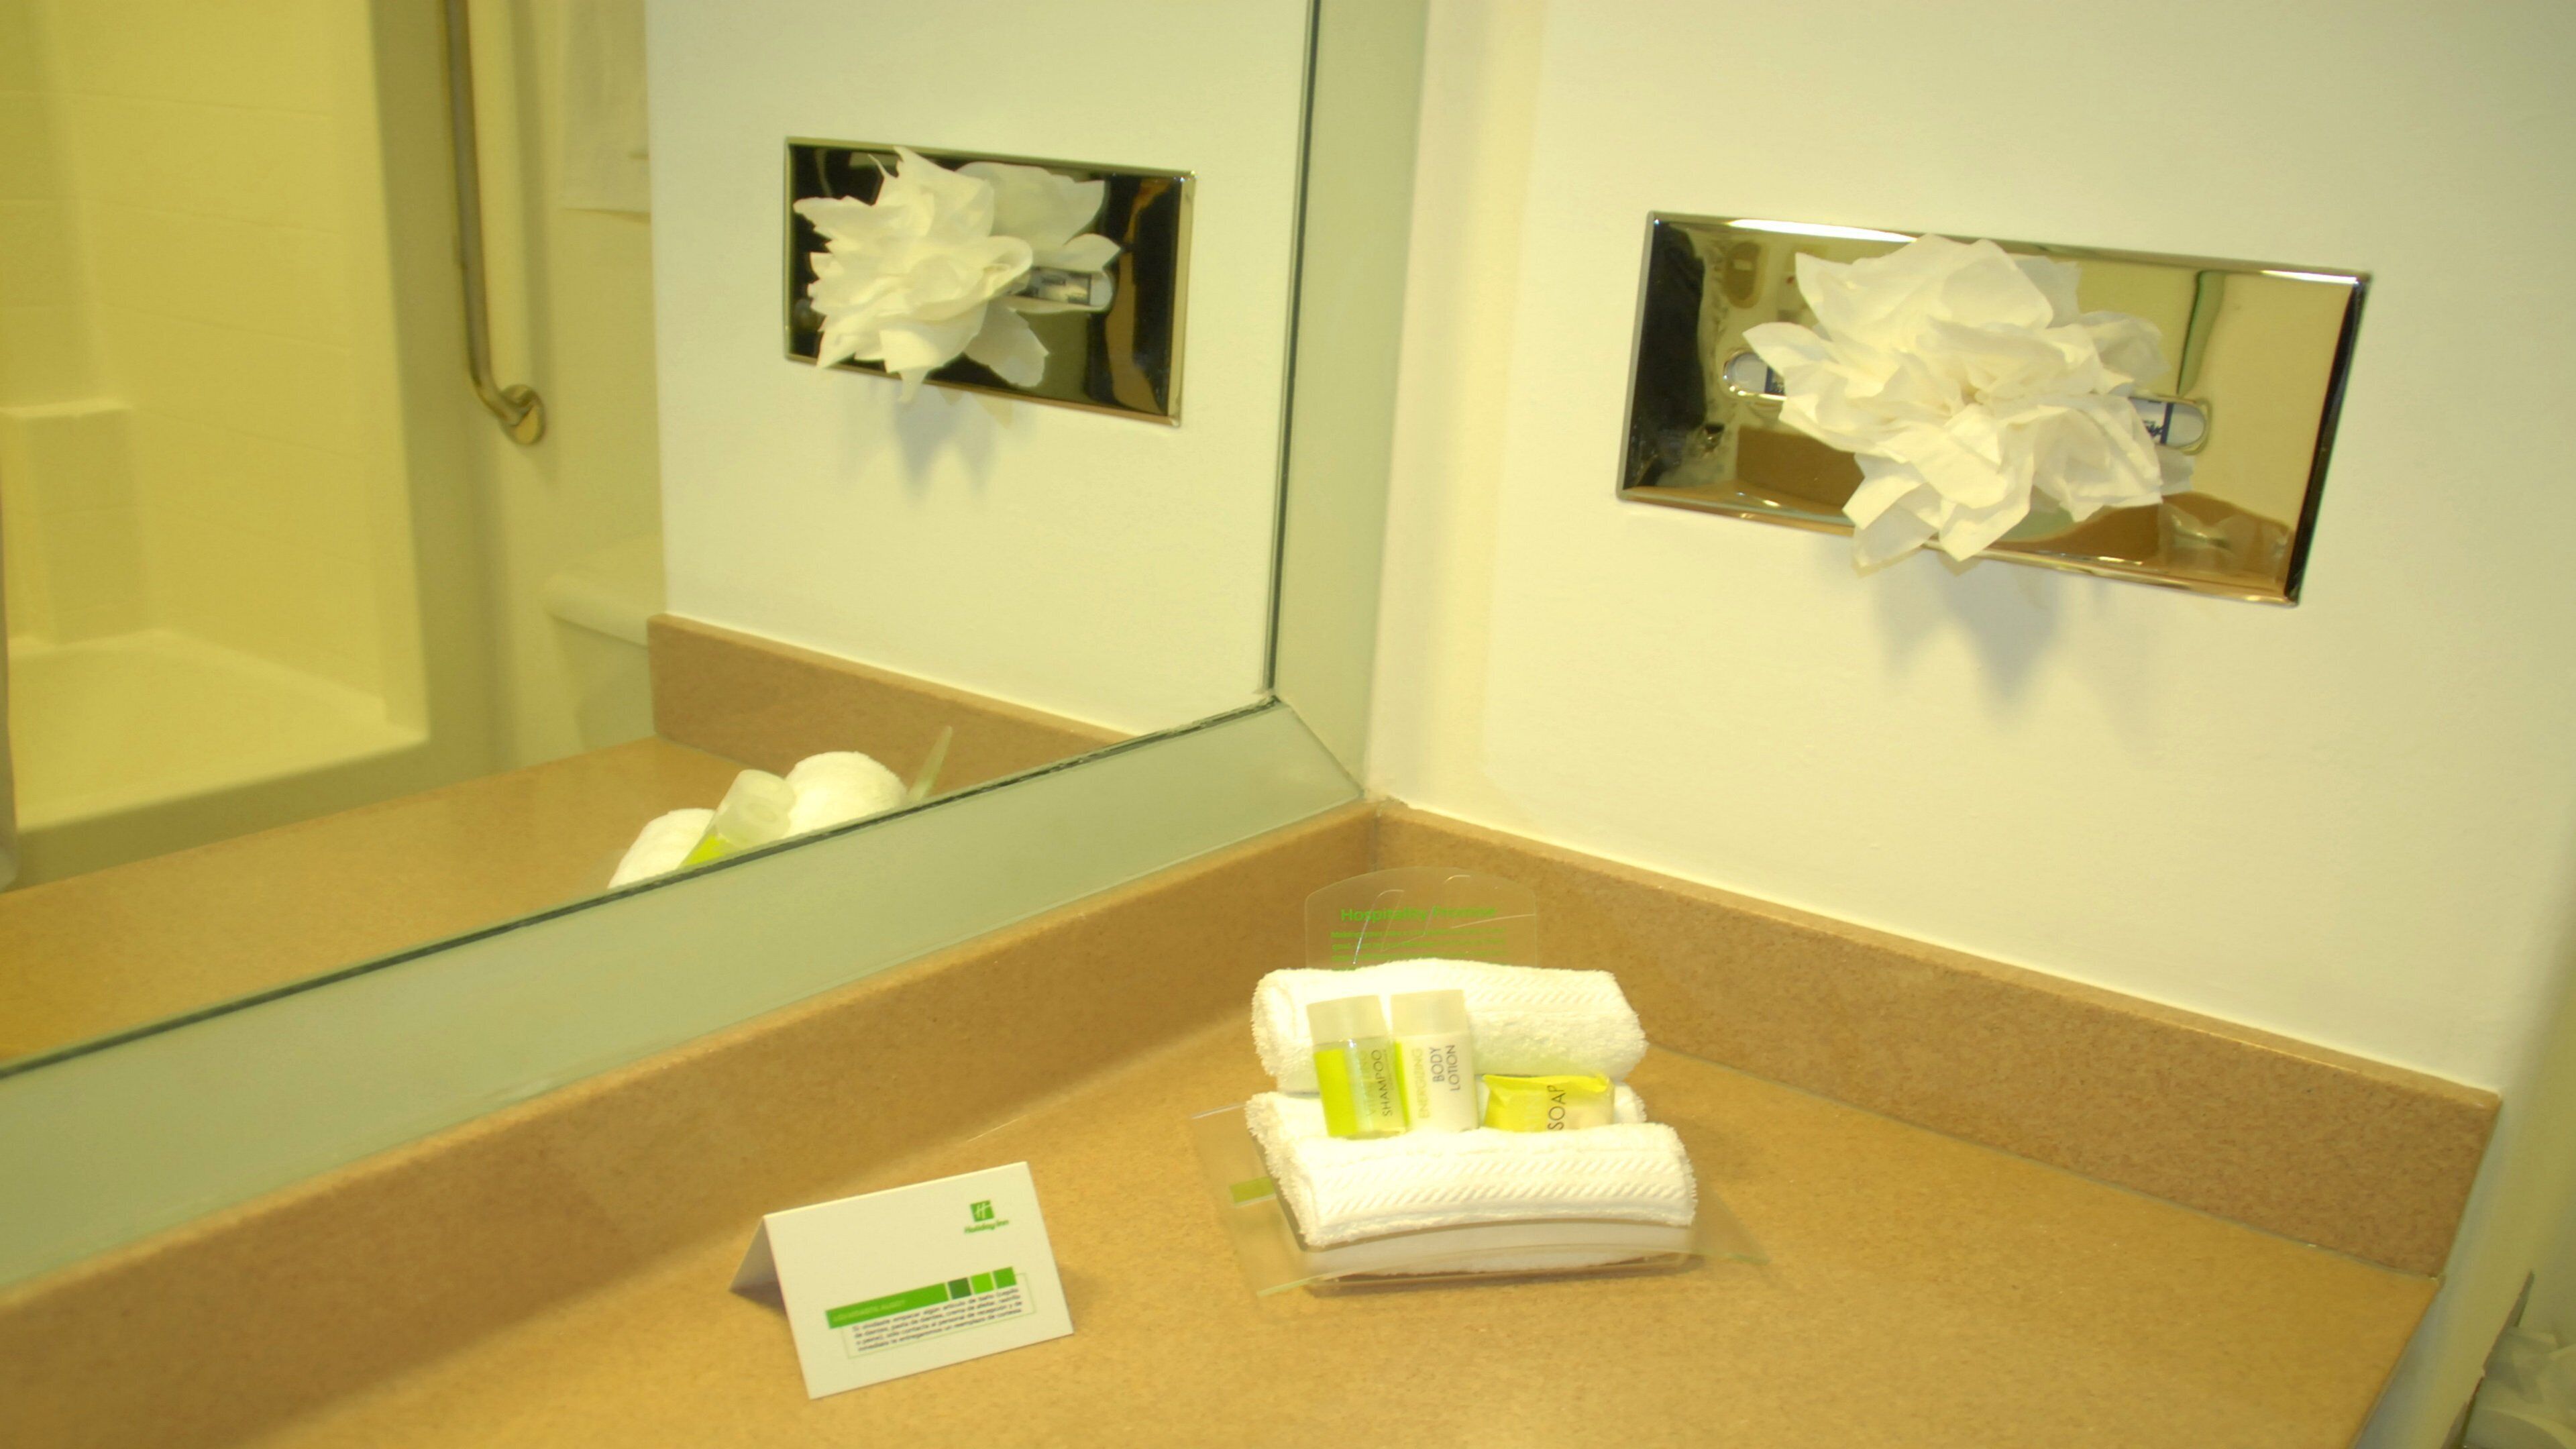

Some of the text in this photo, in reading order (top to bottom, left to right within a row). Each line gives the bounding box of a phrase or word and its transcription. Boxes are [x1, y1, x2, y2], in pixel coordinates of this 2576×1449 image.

[1341, 907, 1428, 924] Hospitality
[1371, 1049, 1393, 1116] SHAMPOO
[1413, 1046, 1430, 1118] ENERGIZING
[1430, 1046, 1445, 1083] BODY
[1445, 1044, 1460, 1091] LOTION
[1546, 1085, 1566, 1131] SOAP
[964, 1224, 996, 1234] Holiday
